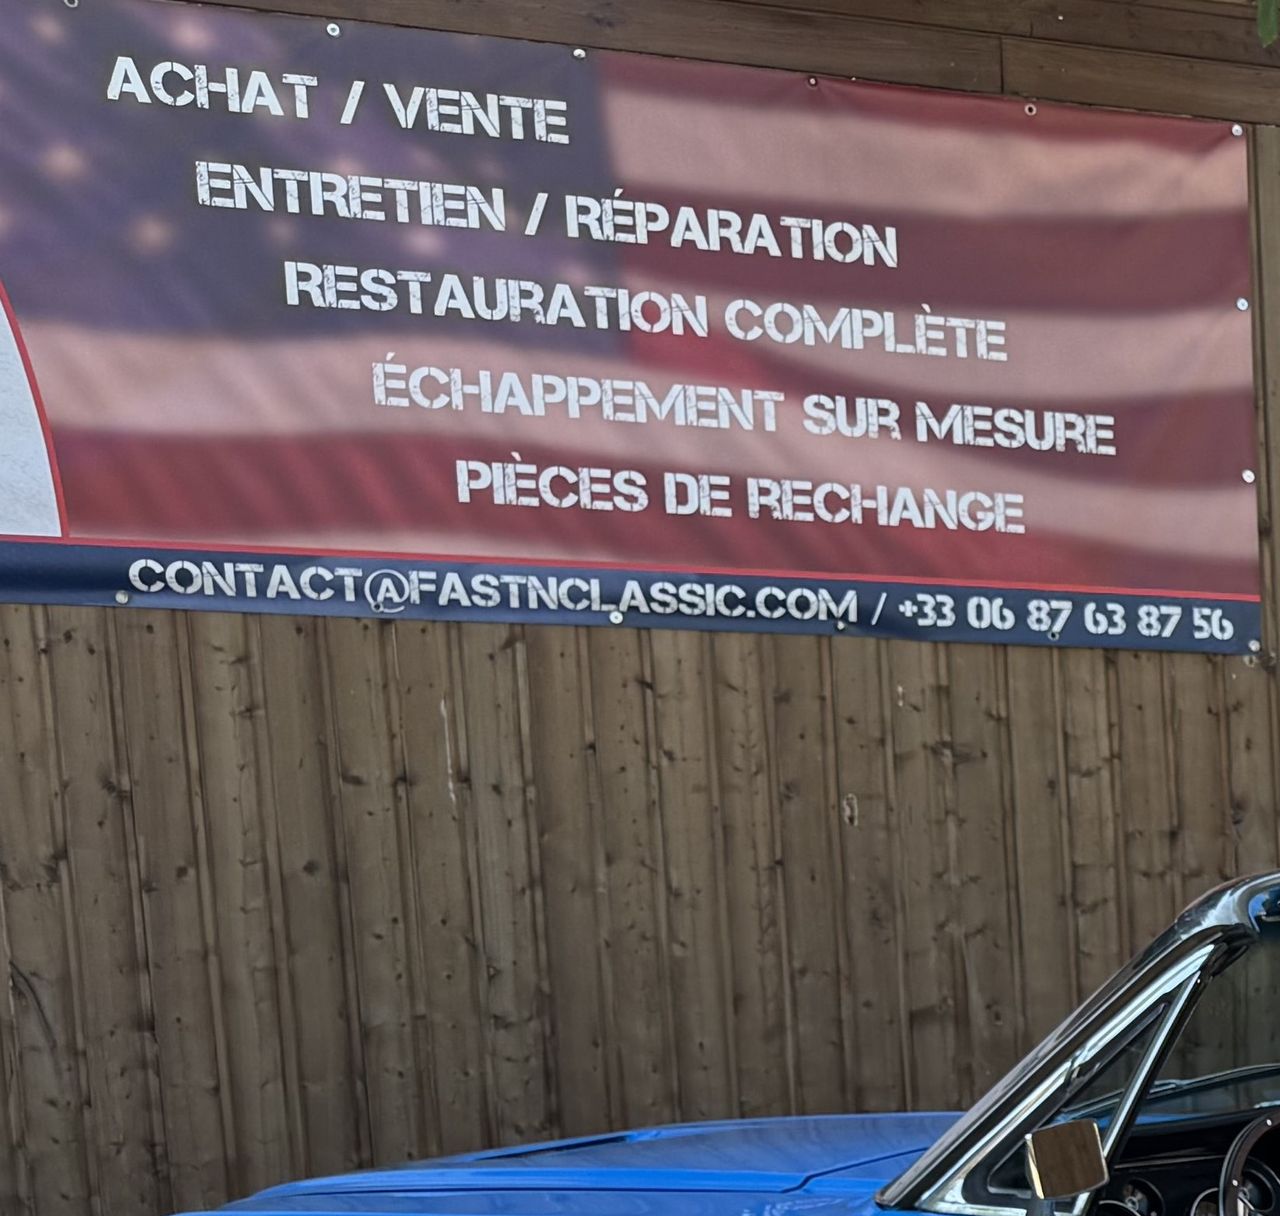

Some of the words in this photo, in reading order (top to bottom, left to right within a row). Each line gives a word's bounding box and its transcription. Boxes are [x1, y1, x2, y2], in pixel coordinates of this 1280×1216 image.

[106, 56, 318, 118] ACHAT
[340, 80, 365, 126] /
[383, 82, 571, 145] VENTE
[195, 160, 506, 231] ENTRETIEN
[524, 192, 548, 236] /
[565, 188, 898, 268] RÉPARATION
[284, 260, 708, 337] RESTAURATION
[724, 298, 1008, 362] COMPLÈTE
[371, 352, 785, 432] ÉCHAPPEMENT
[802, 394, 901, 441] SUR
[915, 402, 1117, 456] MESURE
[454, 451, 649, 512] PIÈCES
[663, 471, 733, 518] DE
[747, 477, 1026, 534] RECHANGE
[128, 557, 858, 624] CONTACT@FASTNCLASSIC.COM
[871, 592, 887, 626] /
[898, 592, 956, 628] +33
[966, 595, 1015, 632] 06
[1026, 599, 1072, 635] 87
[1083, 602, 1126, 636] 63
[1137, 604, 1182, 639] 87
[1192, 607, 1234, 641] 56
